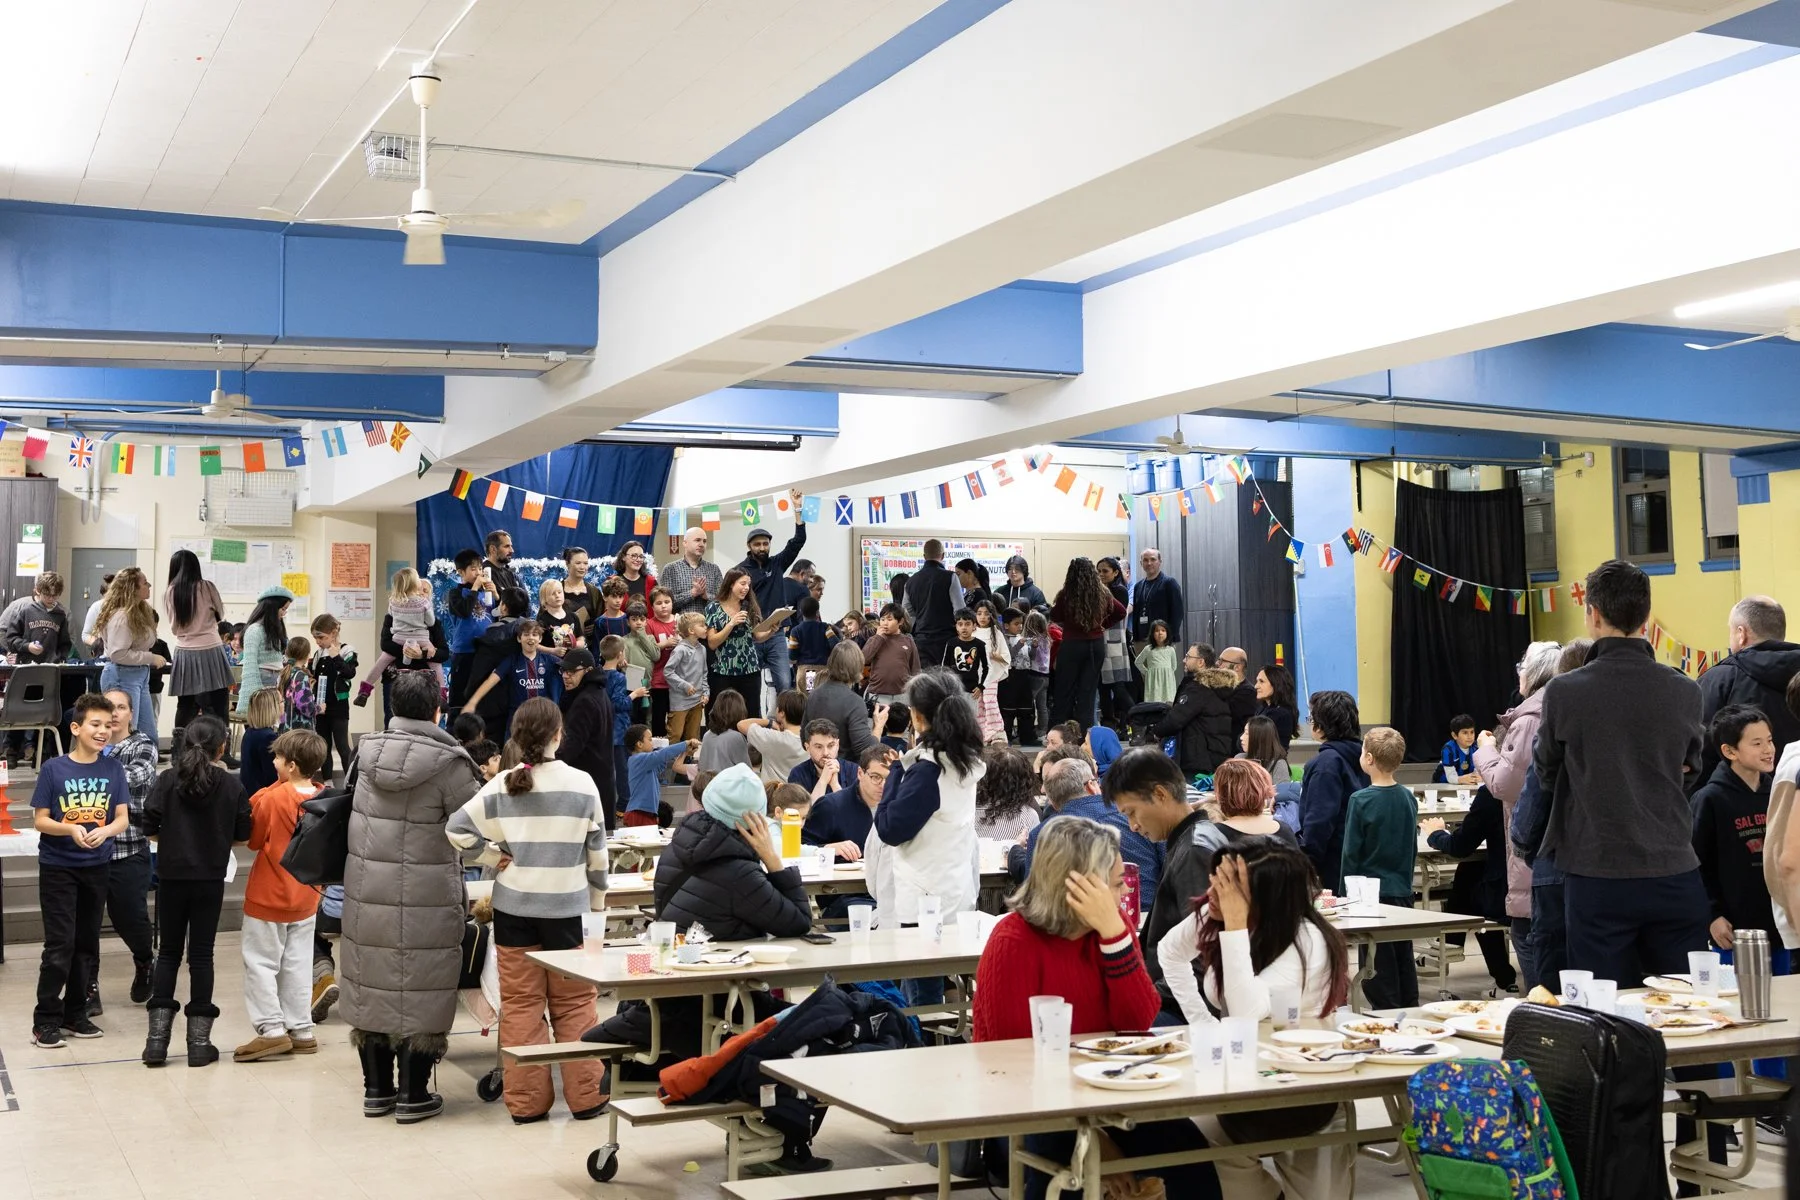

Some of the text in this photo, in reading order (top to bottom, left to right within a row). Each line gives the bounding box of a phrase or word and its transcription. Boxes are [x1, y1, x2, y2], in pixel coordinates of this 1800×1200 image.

[519, 678, 544, 687] QATAR
[64, 778, 109, 792] NEXT
[1735, 813, 1767, 829] SAL GR
